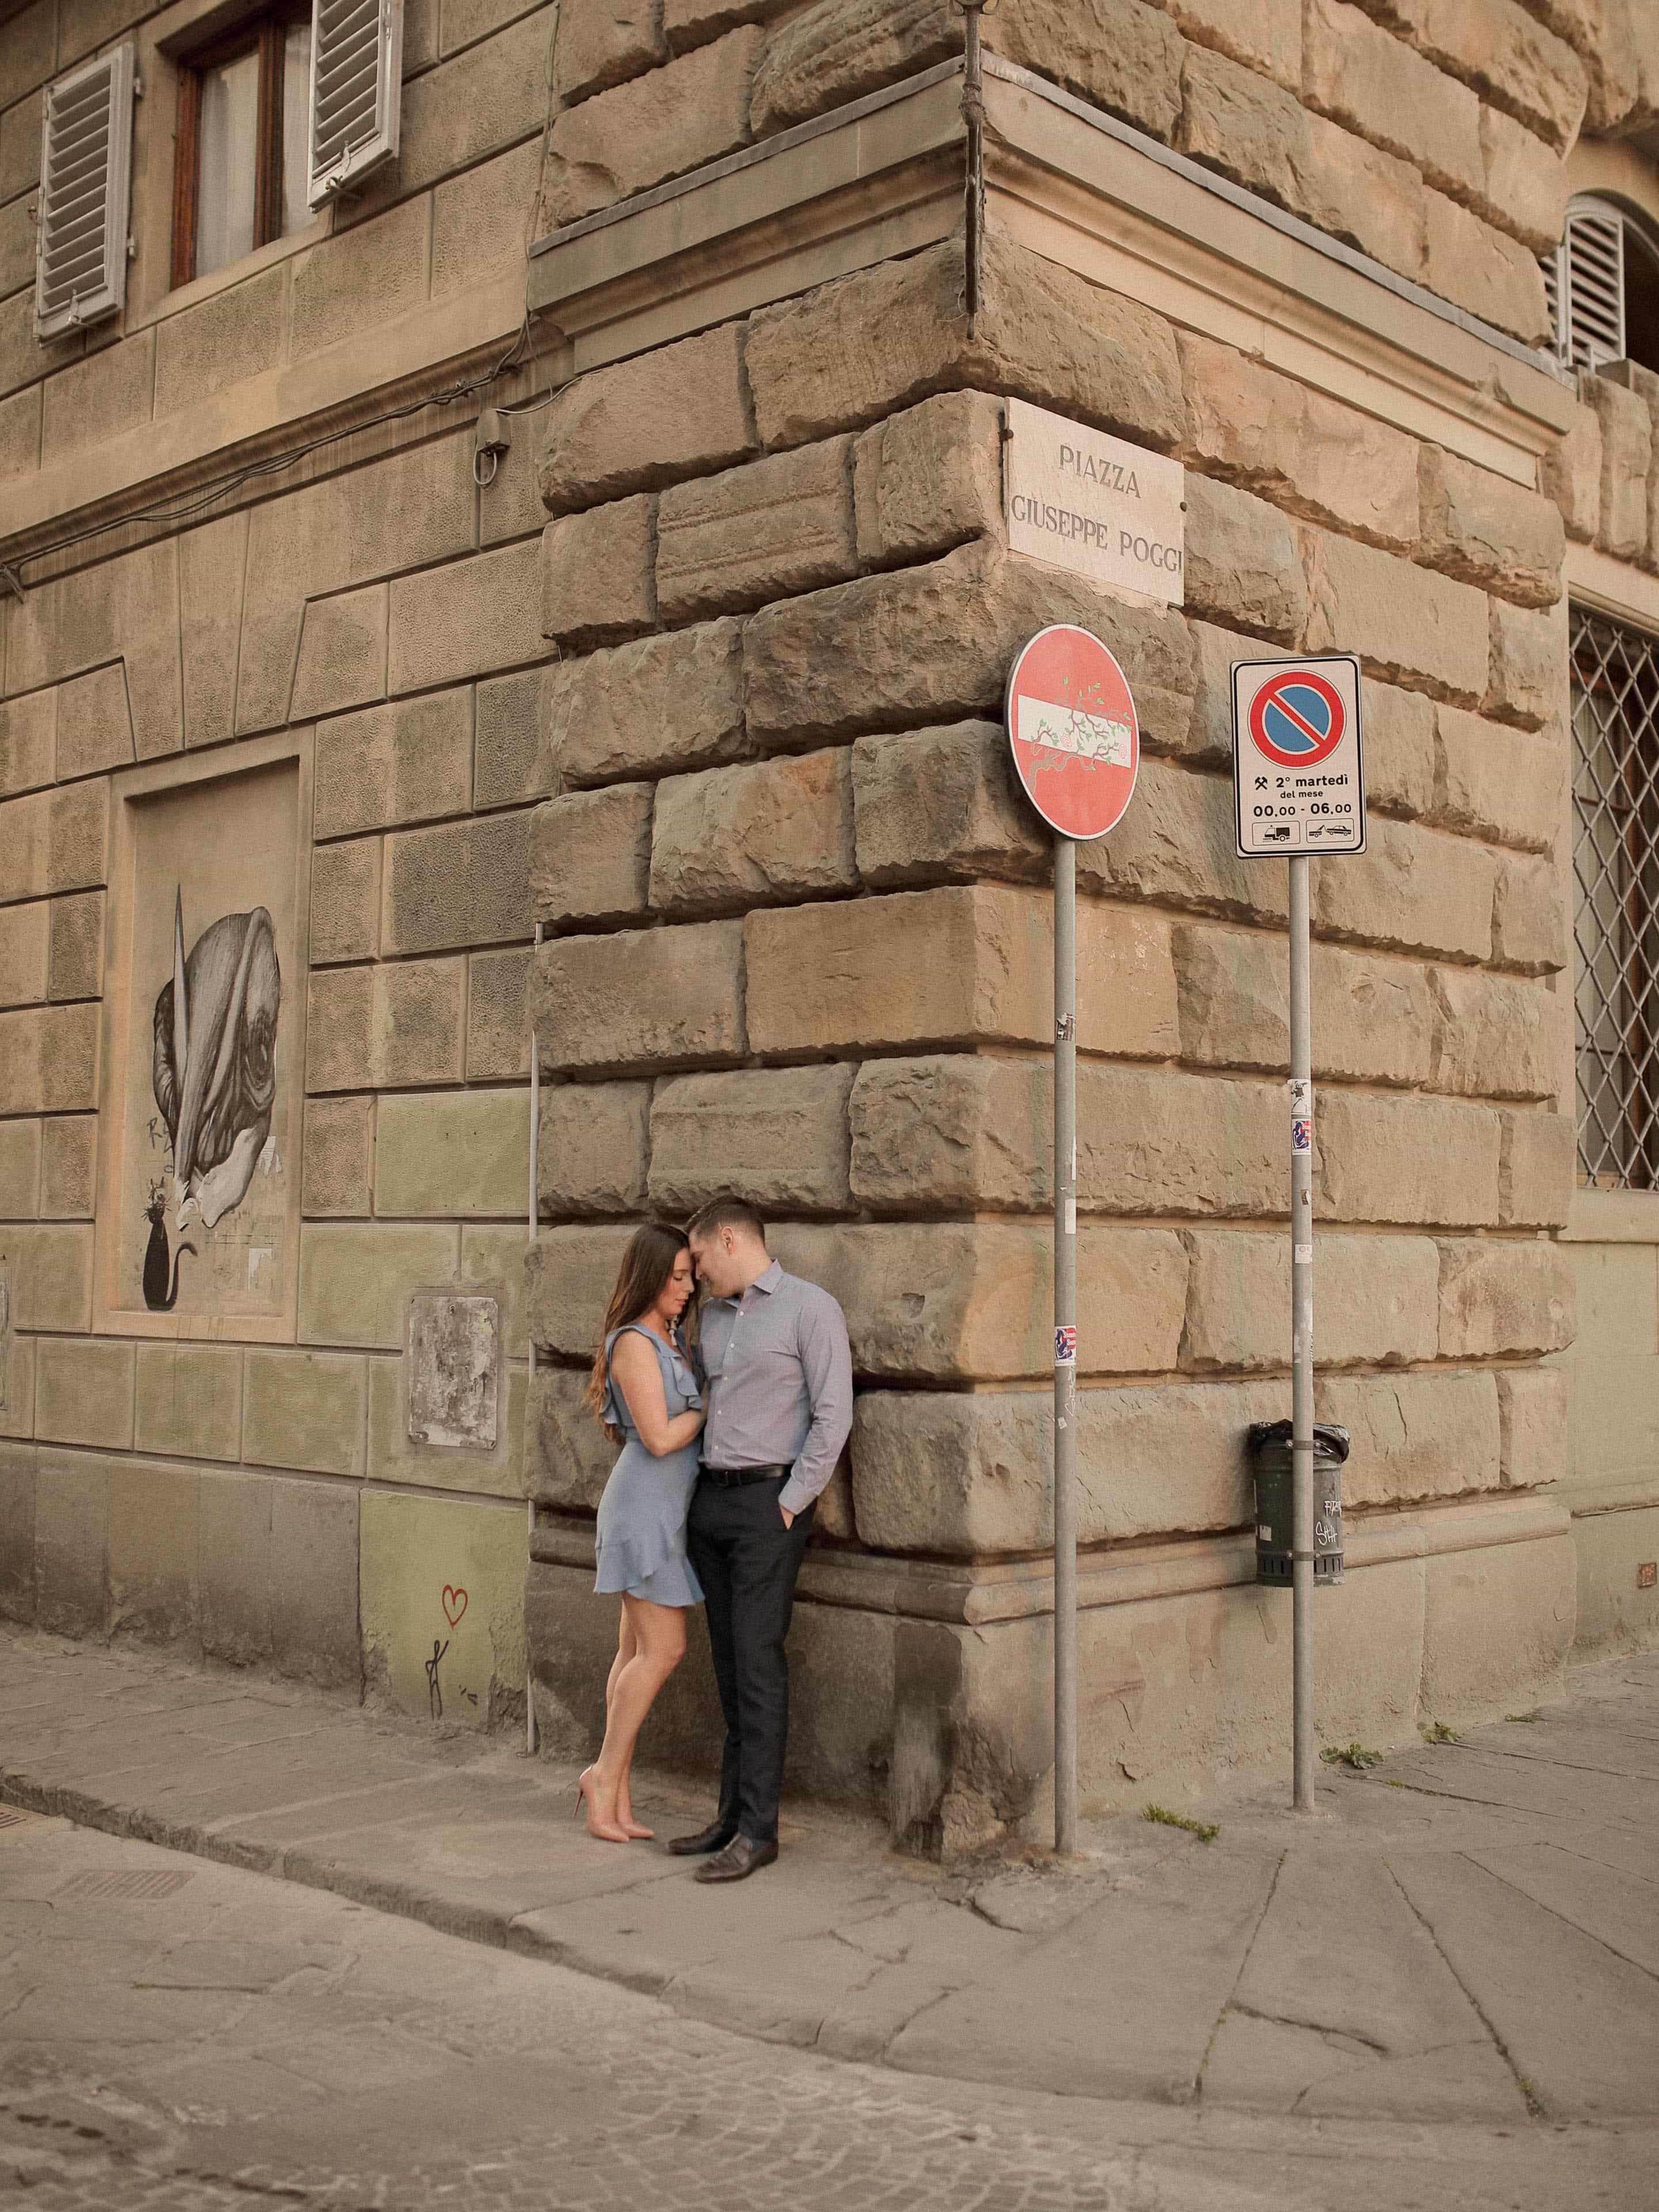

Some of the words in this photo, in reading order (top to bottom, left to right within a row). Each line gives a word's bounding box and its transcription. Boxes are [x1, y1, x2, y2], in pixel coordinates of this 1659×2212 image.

[1060, 445, 1142, 498] PIAZZA
[1012, 495, 1108, 550] GIUSEPPE
[1120, 531, 1183, 575] POGGI
[1296, 774, 1348, 787] martedì
